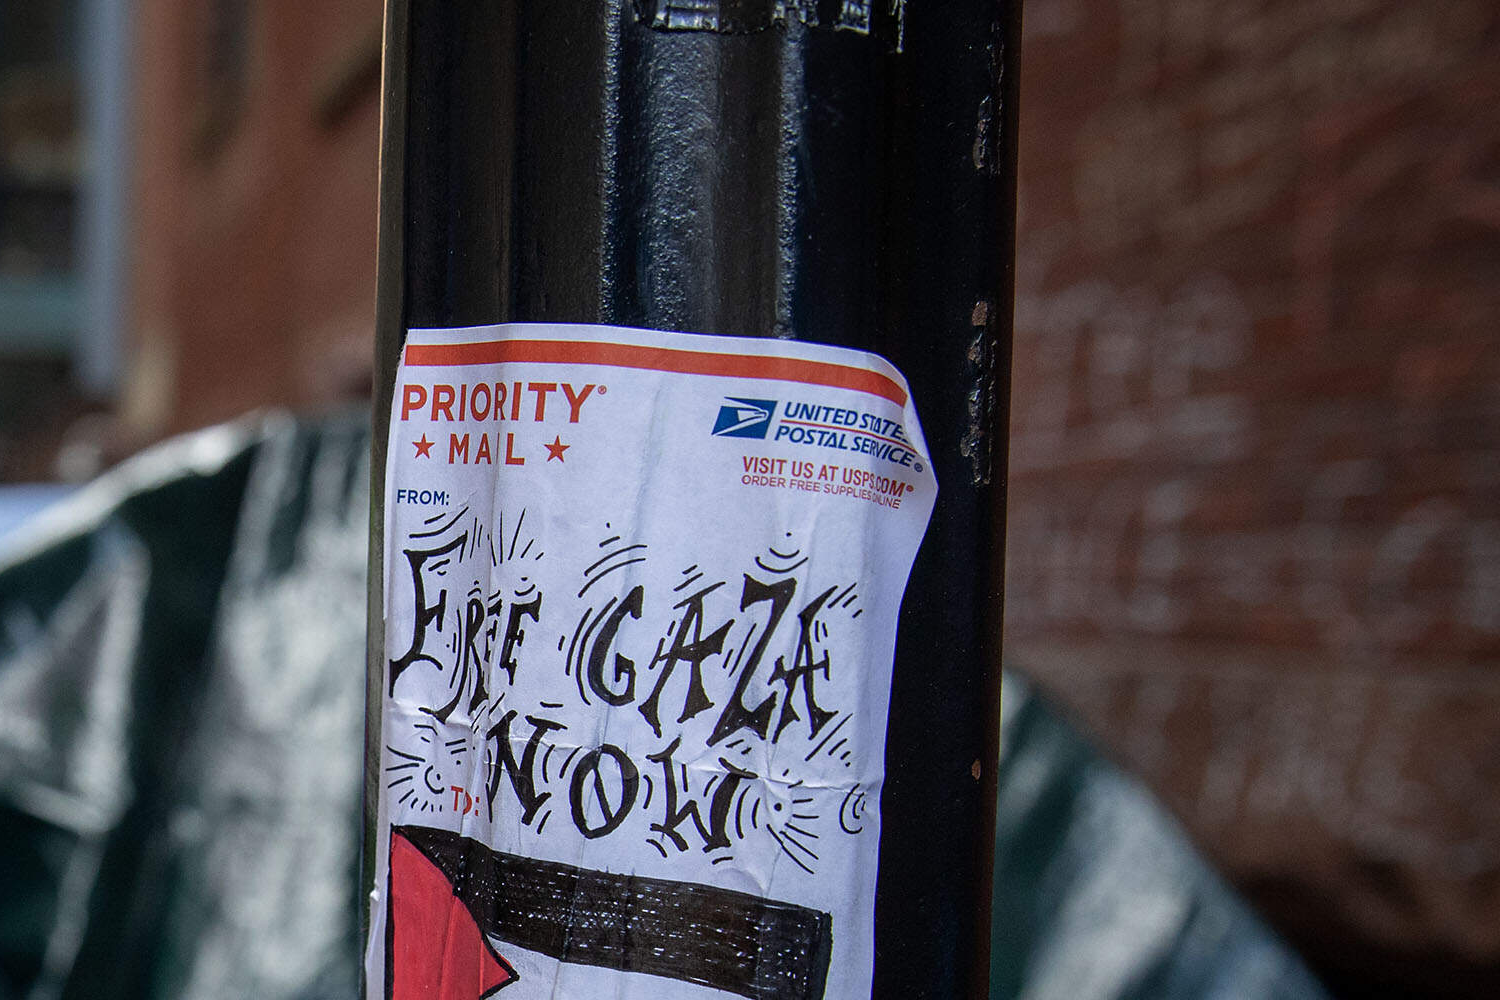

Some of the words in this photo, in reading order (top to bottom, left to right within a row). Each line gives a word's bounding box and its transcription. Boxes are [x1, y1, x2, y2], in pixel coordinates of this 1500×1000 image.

[774, 425, 848, 450] POSTAL
[783, 401, 858, 427] UNITED
[859, 412, 909, 444] STATE
[448, 432, 526, 466] MAIL
[742, 455, 787, 475] VISIT
[791, 460, 814, 480] US
[817, 465, 839, 483] AT
[396, 488, 450, 506] FROM:
[740, 473, 786, 489] ORDER
[789, 478, 821, 493] FREE
[823, 483, 873, 502] SUPPLIES
[388, 530, 543, 725] FREE
[586, 573, 840, 747] GAZA
[485, 709, 759, 854] NOW
